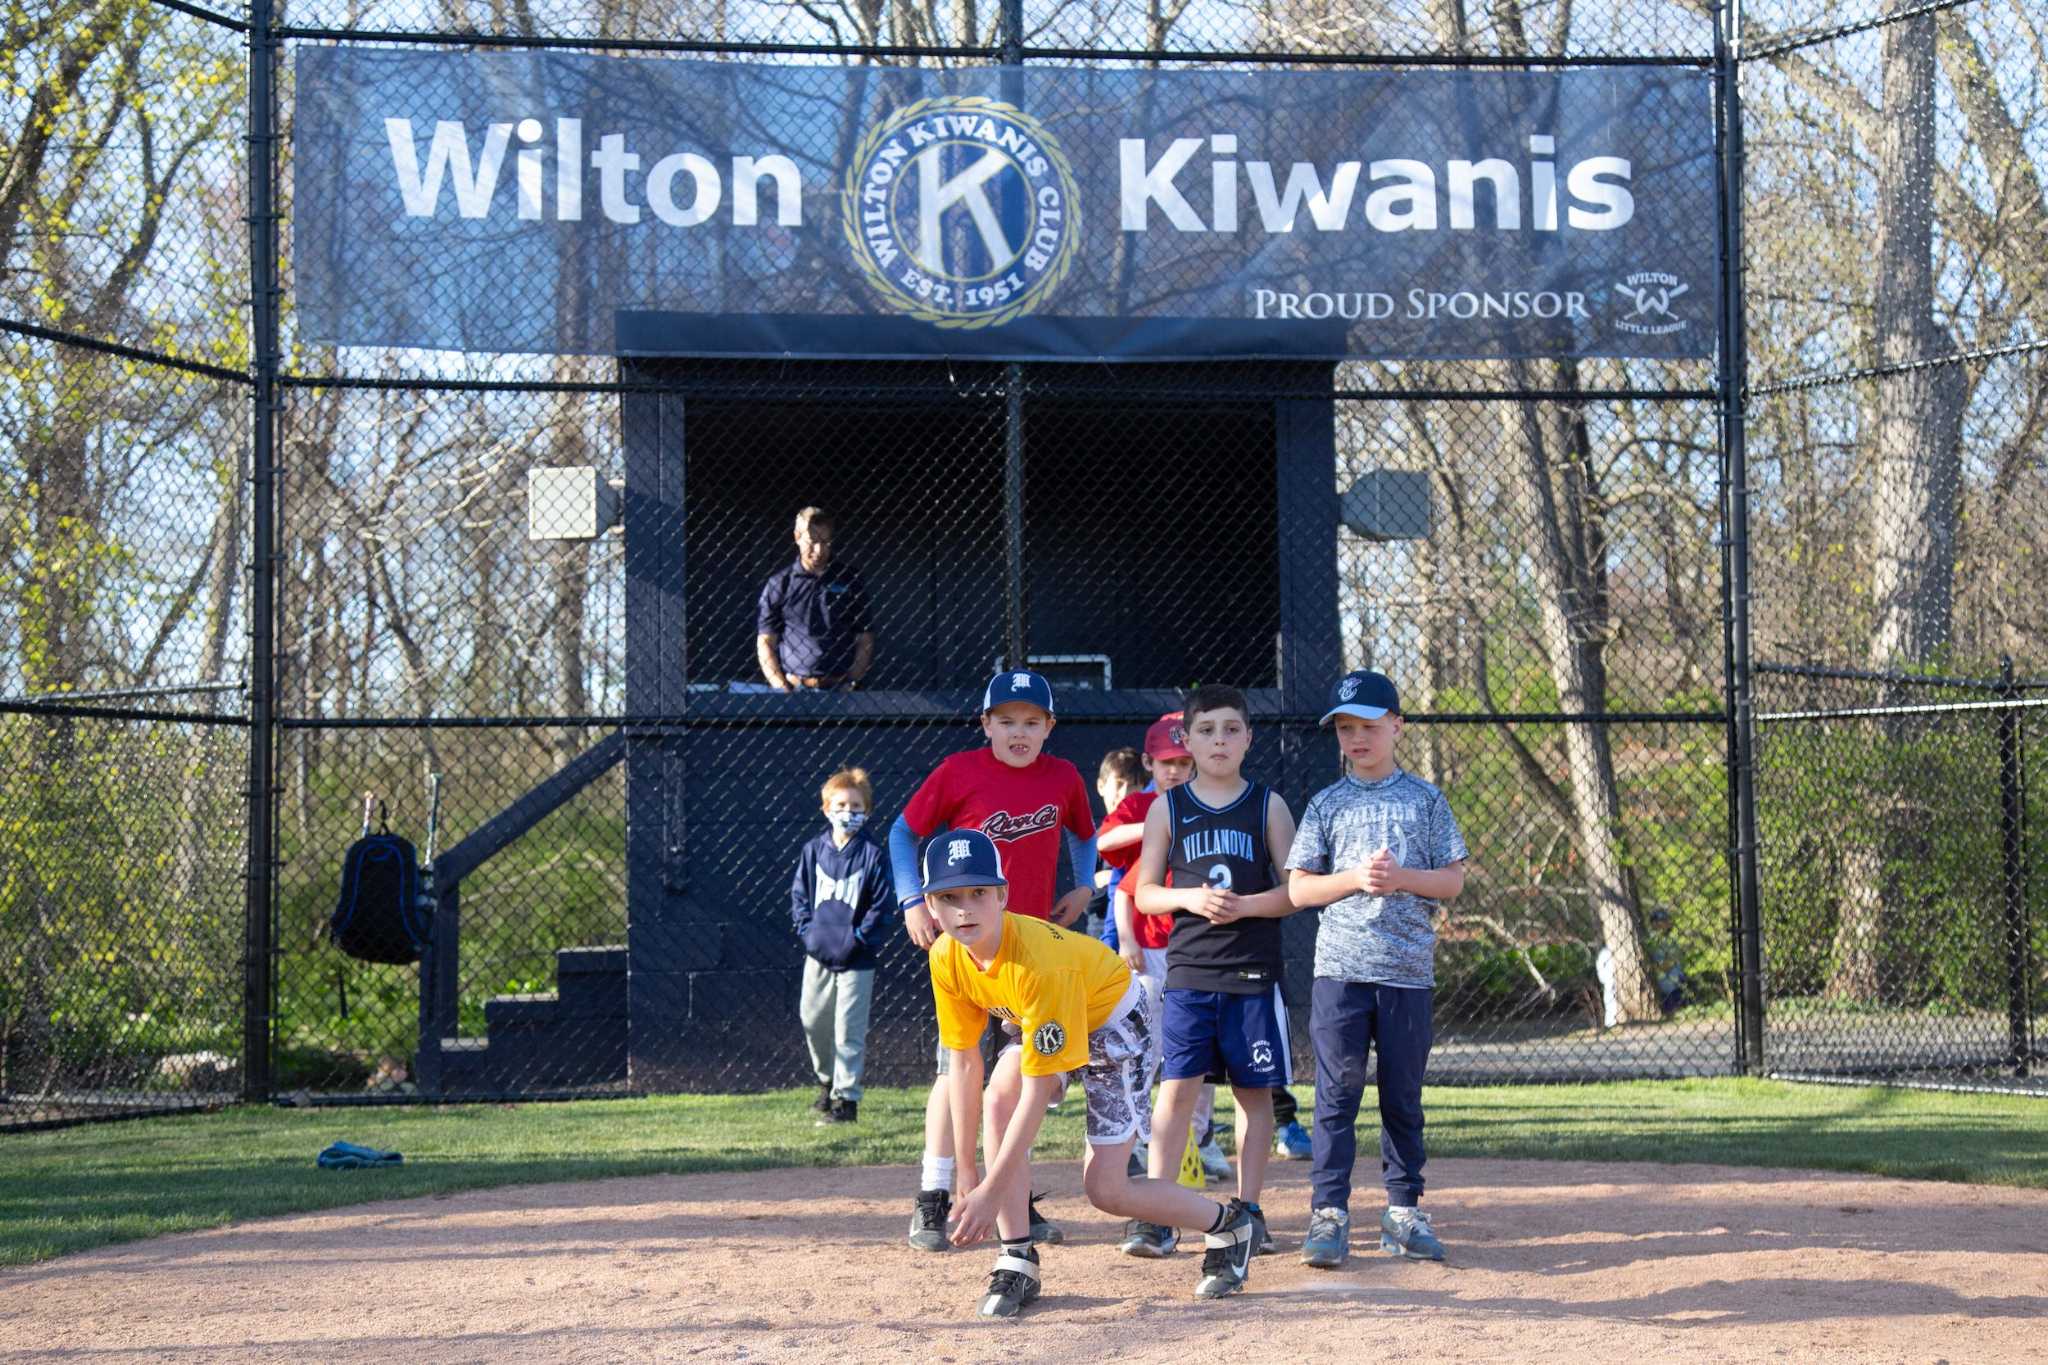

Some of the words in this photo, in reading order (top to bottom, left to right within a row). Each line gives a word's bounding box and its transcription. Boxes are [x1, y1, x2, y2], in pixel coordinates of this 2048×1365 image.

[384, 117, 802, 227] Wilton
[863, 138, 908, 269] WILTON
[906, 115, 1048, 177] KIWANIS
[1024, 186, 1062, 272] CLUB
[1119, 134, 1635, 233] Kiwanis
[915, 143, 1014, 276] K
[900, 268, 954, 305] EST.
[965, 272, 1025, 307] 1951
[1626, 272, 1678, 286] WILTON
[1615, 320, 1649, 335] LITTLE
[1651, 320, 1687, 335] LEAGUE
[1183, 828, 1255, 864] VILLANOVA
